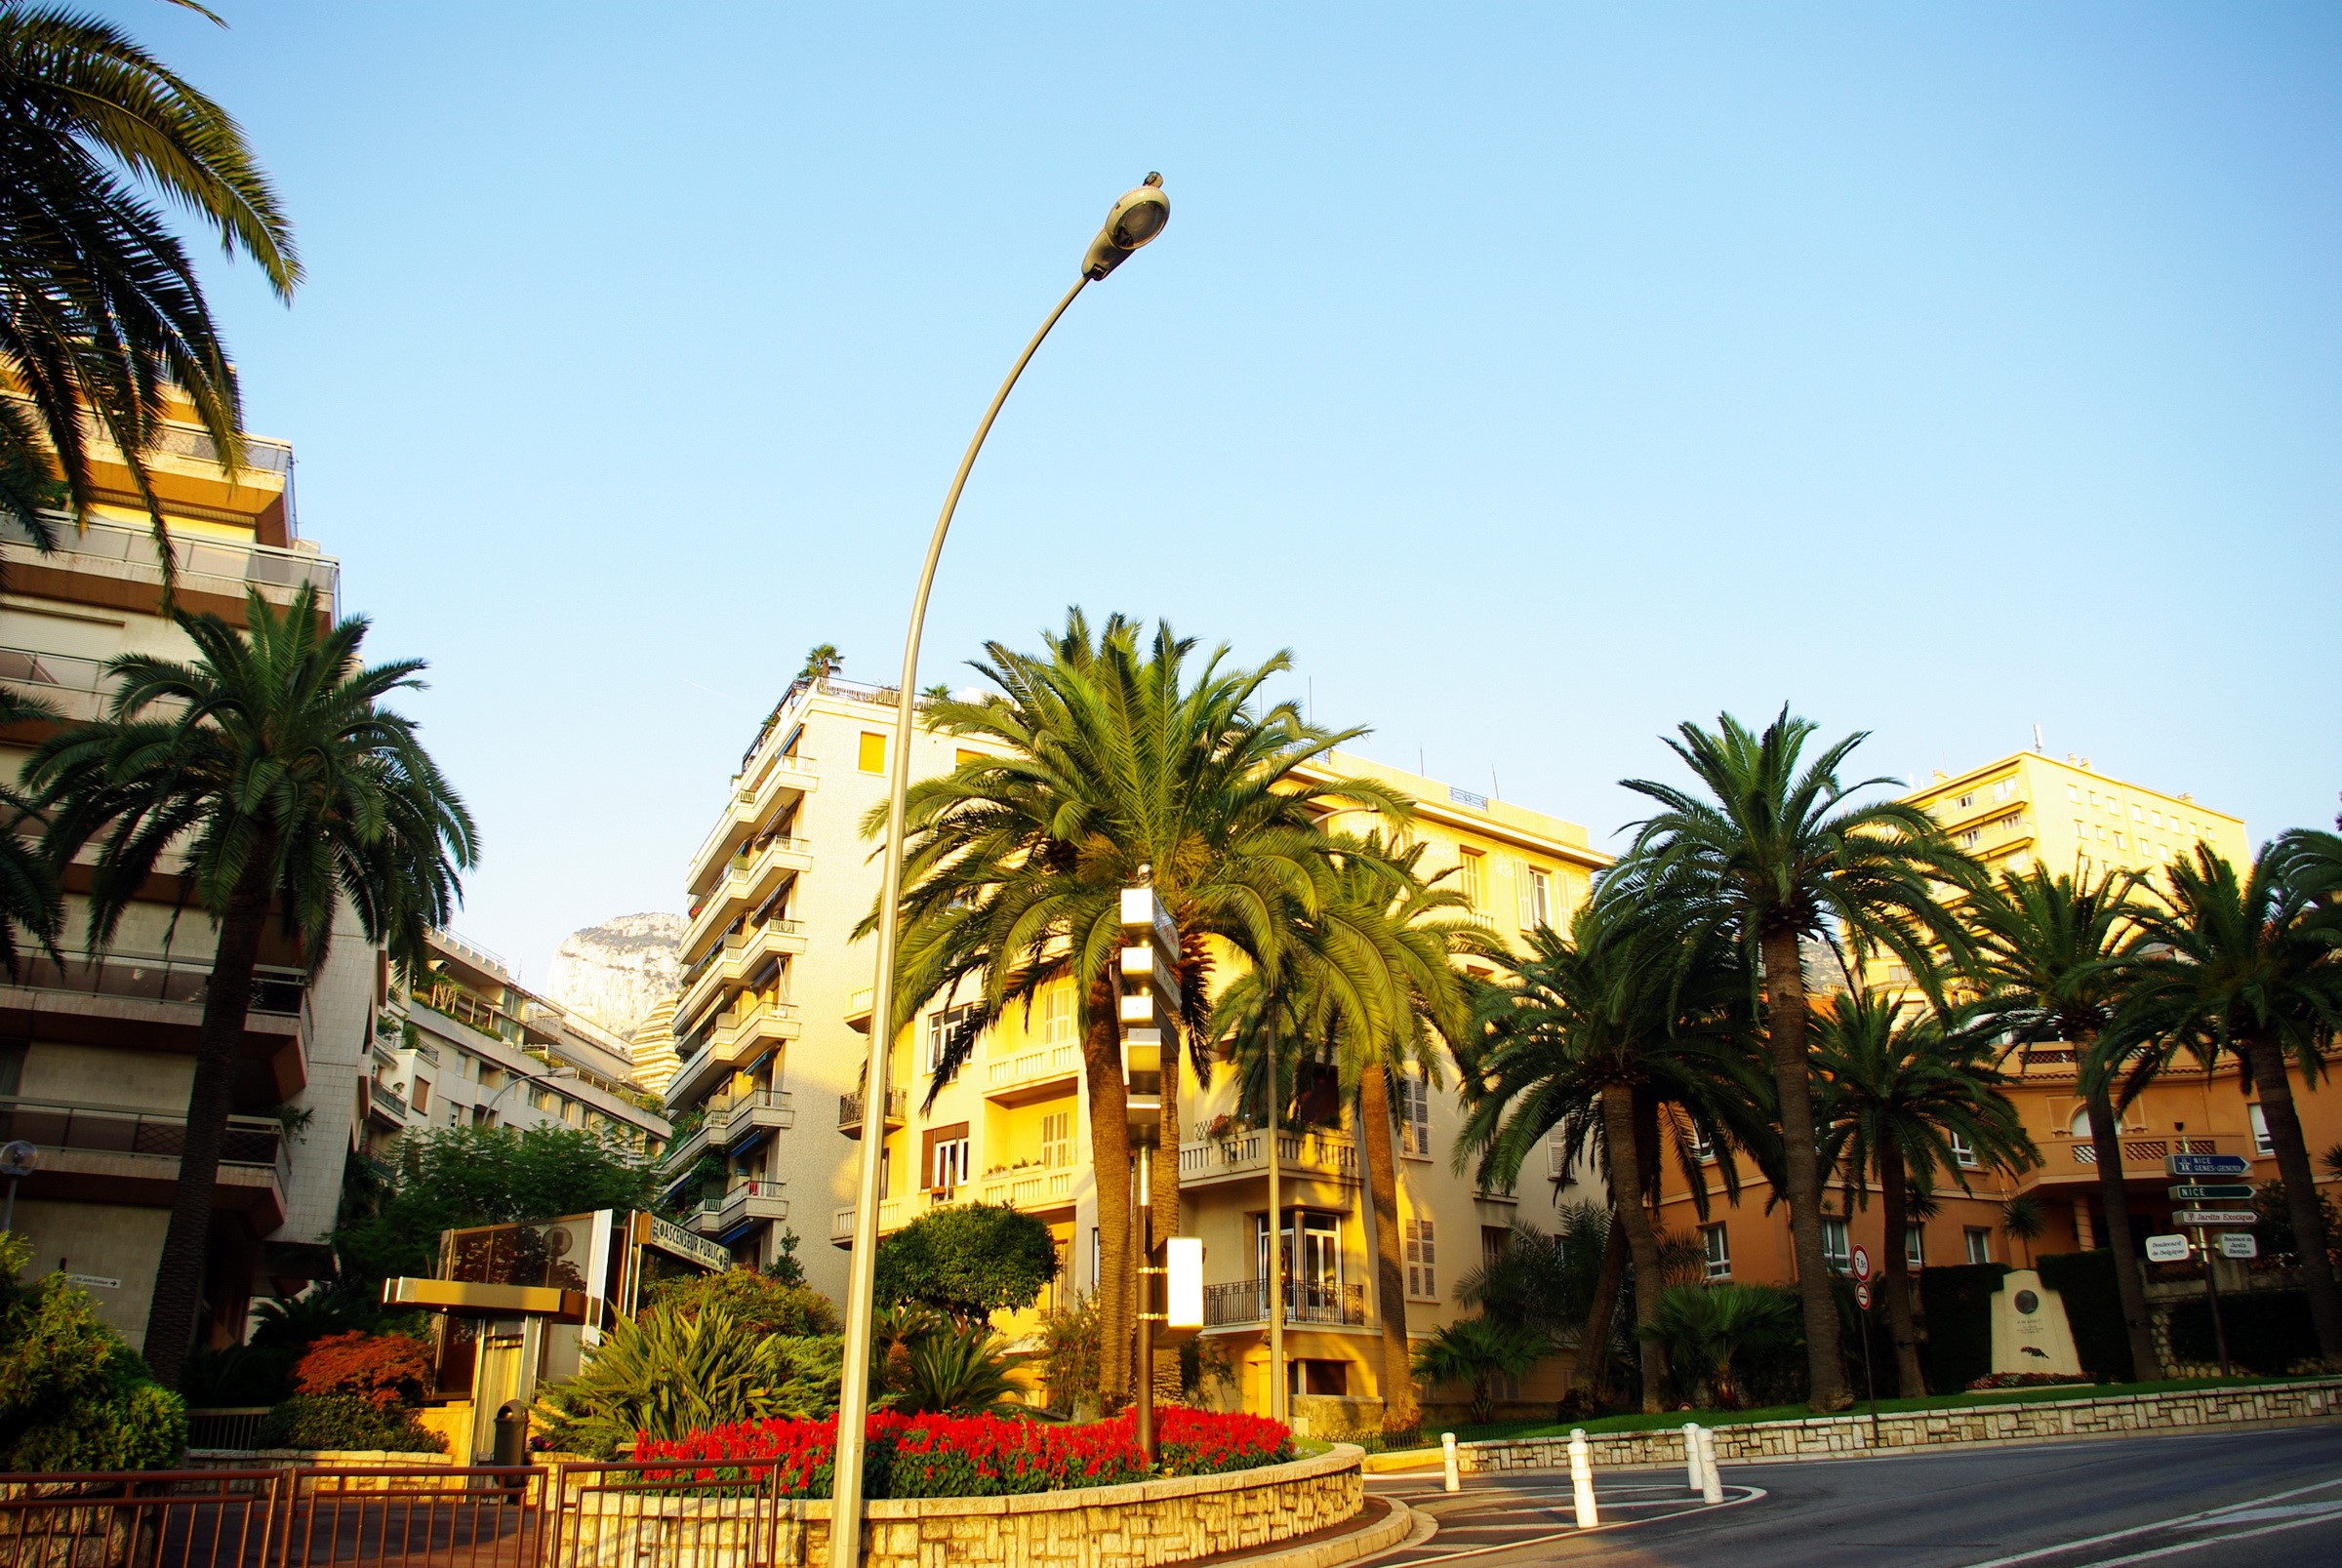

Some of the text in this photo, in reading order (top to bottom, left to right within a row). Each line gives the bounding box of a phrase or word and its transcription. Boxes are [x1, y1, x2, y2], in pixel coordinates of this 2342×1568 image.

[2181, 1187, 2205, 1196] NICE
[2222, 1213, 2254, 1223] Exotique
[665, 1224, 699, 1253] ASCENSEUR
[700, 1239, 720, 1262] PUBLIC
